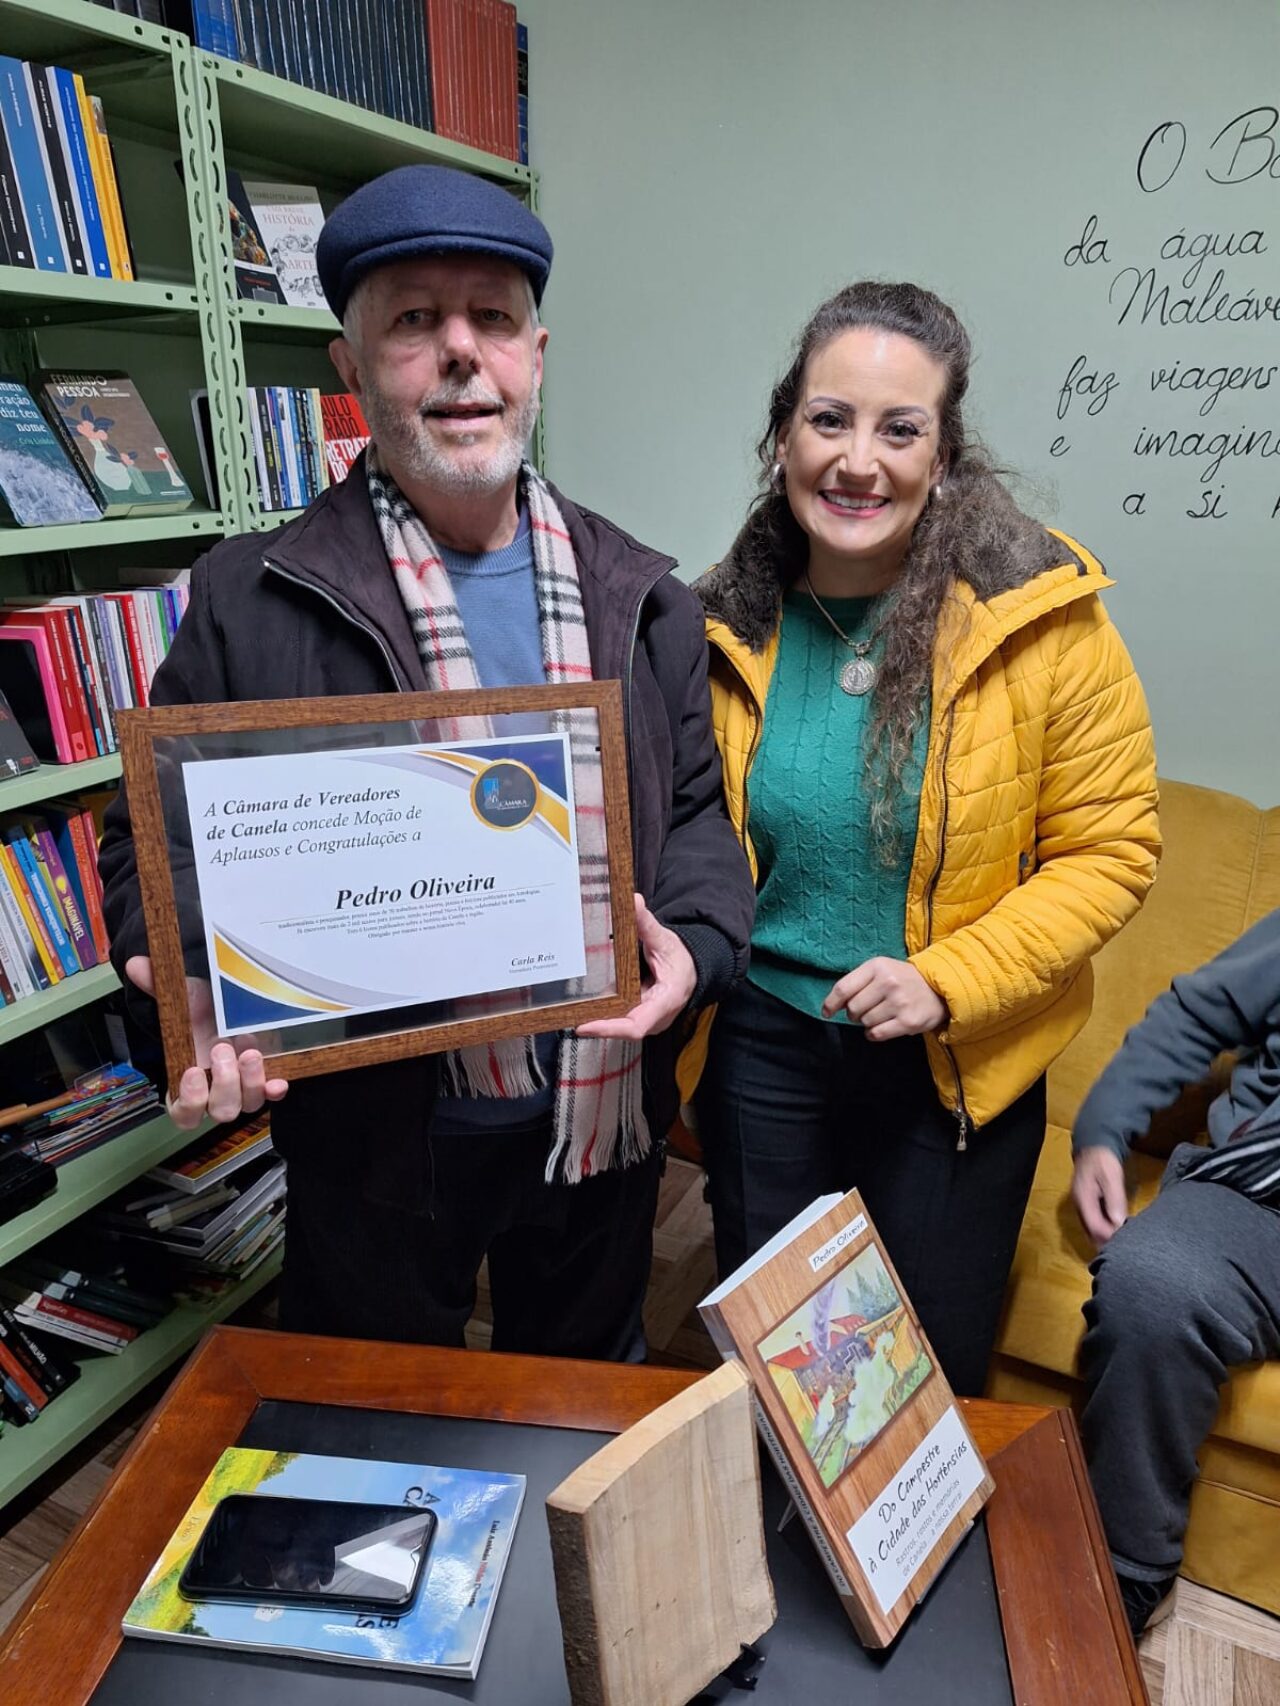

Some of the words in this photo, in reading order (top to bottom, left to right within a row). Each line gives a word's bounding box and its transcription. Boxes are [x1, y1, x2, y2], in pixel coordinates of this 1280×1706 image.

[1136, 120, 1187, 193] O
[1064, 214, 1111, 267] da
[1160, 227, 1268, 289] água
[50, 373, 107, 386] FERNANDO
[56, 385, 102, 398] PESSOA
[1057, 355, 1120, 420] faz
[1150, 360, 1278, 417] viagens
[19, 409, 39, 419] teu
[321, 396, 351, 417] AULO
[16, 423, 47, 432] nome
[324, 417, 360, 439] RADO
[1050, 435, 1072, 457] e
[1133, 425, 1280, 483] imagin
[1122, 492, 1146, 515] a
[1186, 484, 1229, 519] si
[203, 802, 217, 818] A
[223, 798, 288, 816] Câmara
[294, 793, 312, 809] de
[318, 787, 401, 807] Vereadores
[207, 825, 225, 841] de
[231, 819, 288, 838] Canela
[293, 812, 349, 832] concede
[353, 808, 402, 828] Moção
[406, 804, 423, 820] de
[210, 845, 281, 867] Aplausos
[285, 845, 293, 856] e
[297, 830, 408, 855] Congratulações
[412, 831, 422, 842] a
[335, 884, 402, 909] Pedro
[410, 873, 496, 900] Oliveira
[511, 955, 535, 967] Carla
[813, 1247, 836, 1268] Pedro
[837, 1220, 864, 1245] Oliveira
[878, 1516, 910, 1560] Cidade
[912, 1494, 927, 1519] das
[926, 1441, 967, 1497] Hortênsias
[879, 1502, 896, 1524] Do
[898, 1445, 940, 1501] Campestre
